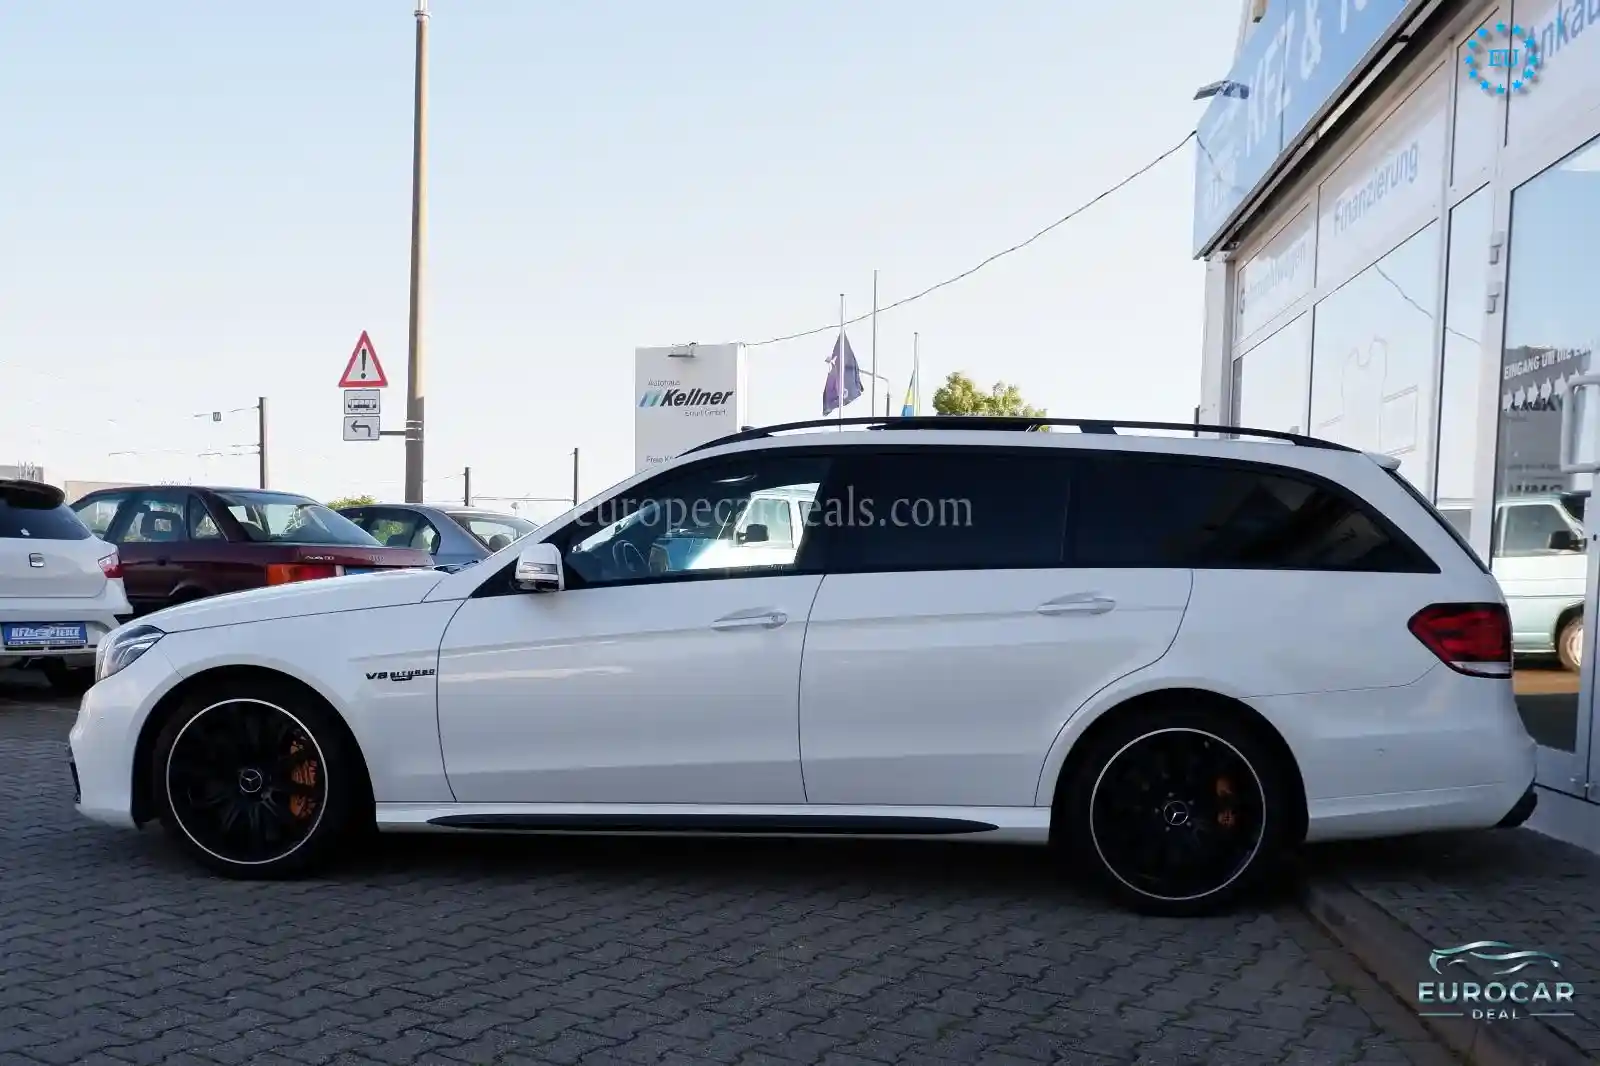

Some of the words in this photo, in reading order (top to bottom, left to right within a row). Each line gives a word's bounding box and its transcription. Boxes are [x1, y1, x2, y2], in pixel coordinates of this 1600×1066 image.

[1333, 141, 1418, 237] Finanzierung
[1504, 355, 1541, 380] EINGANG
[660, 388, 734, 407] Kellner
[365, 671, 388, 680] V8
[390, 668, 436, 680] BITURBO
